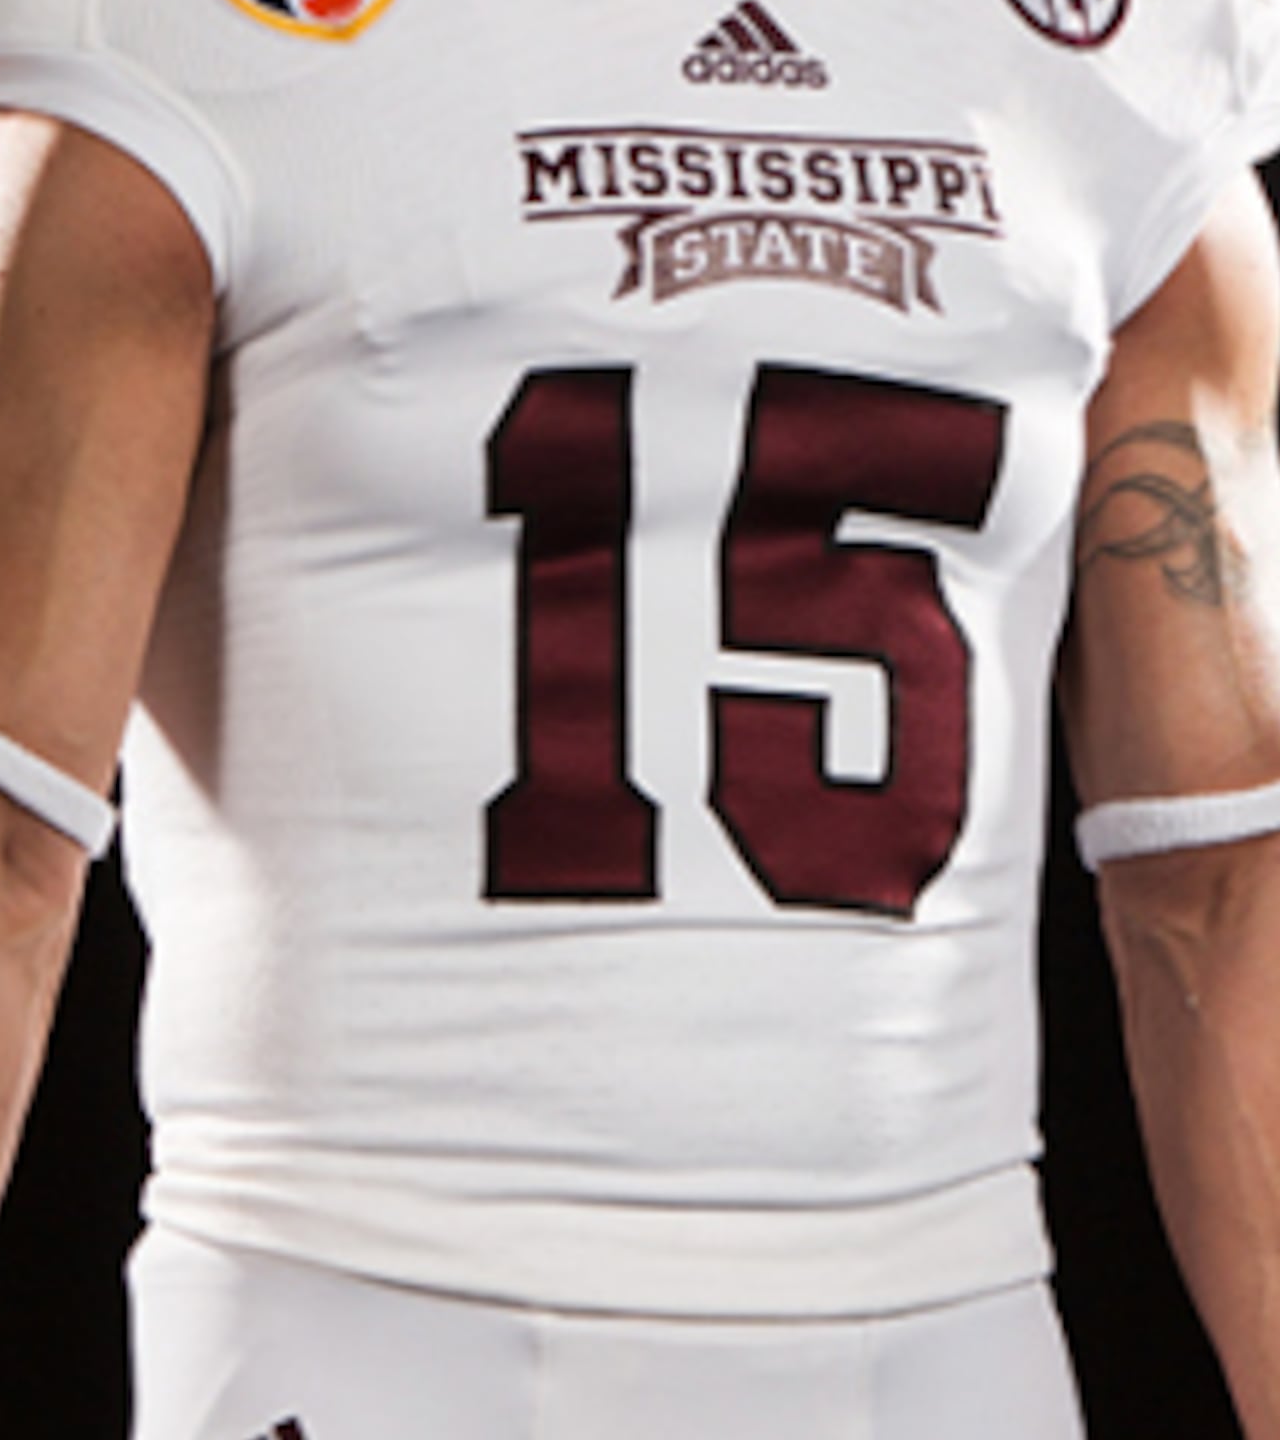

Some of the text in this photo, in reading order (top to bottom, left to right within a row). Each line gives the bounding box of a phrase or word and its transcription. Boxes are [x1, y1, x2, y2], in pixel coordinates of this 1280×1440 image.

[681, 52, 830, 89] adidas
[523, 144, 1000, 221] MISSISSIPPI
[673, 221, 884, 281] STATE
[480, 359, 1011, 921] 15
